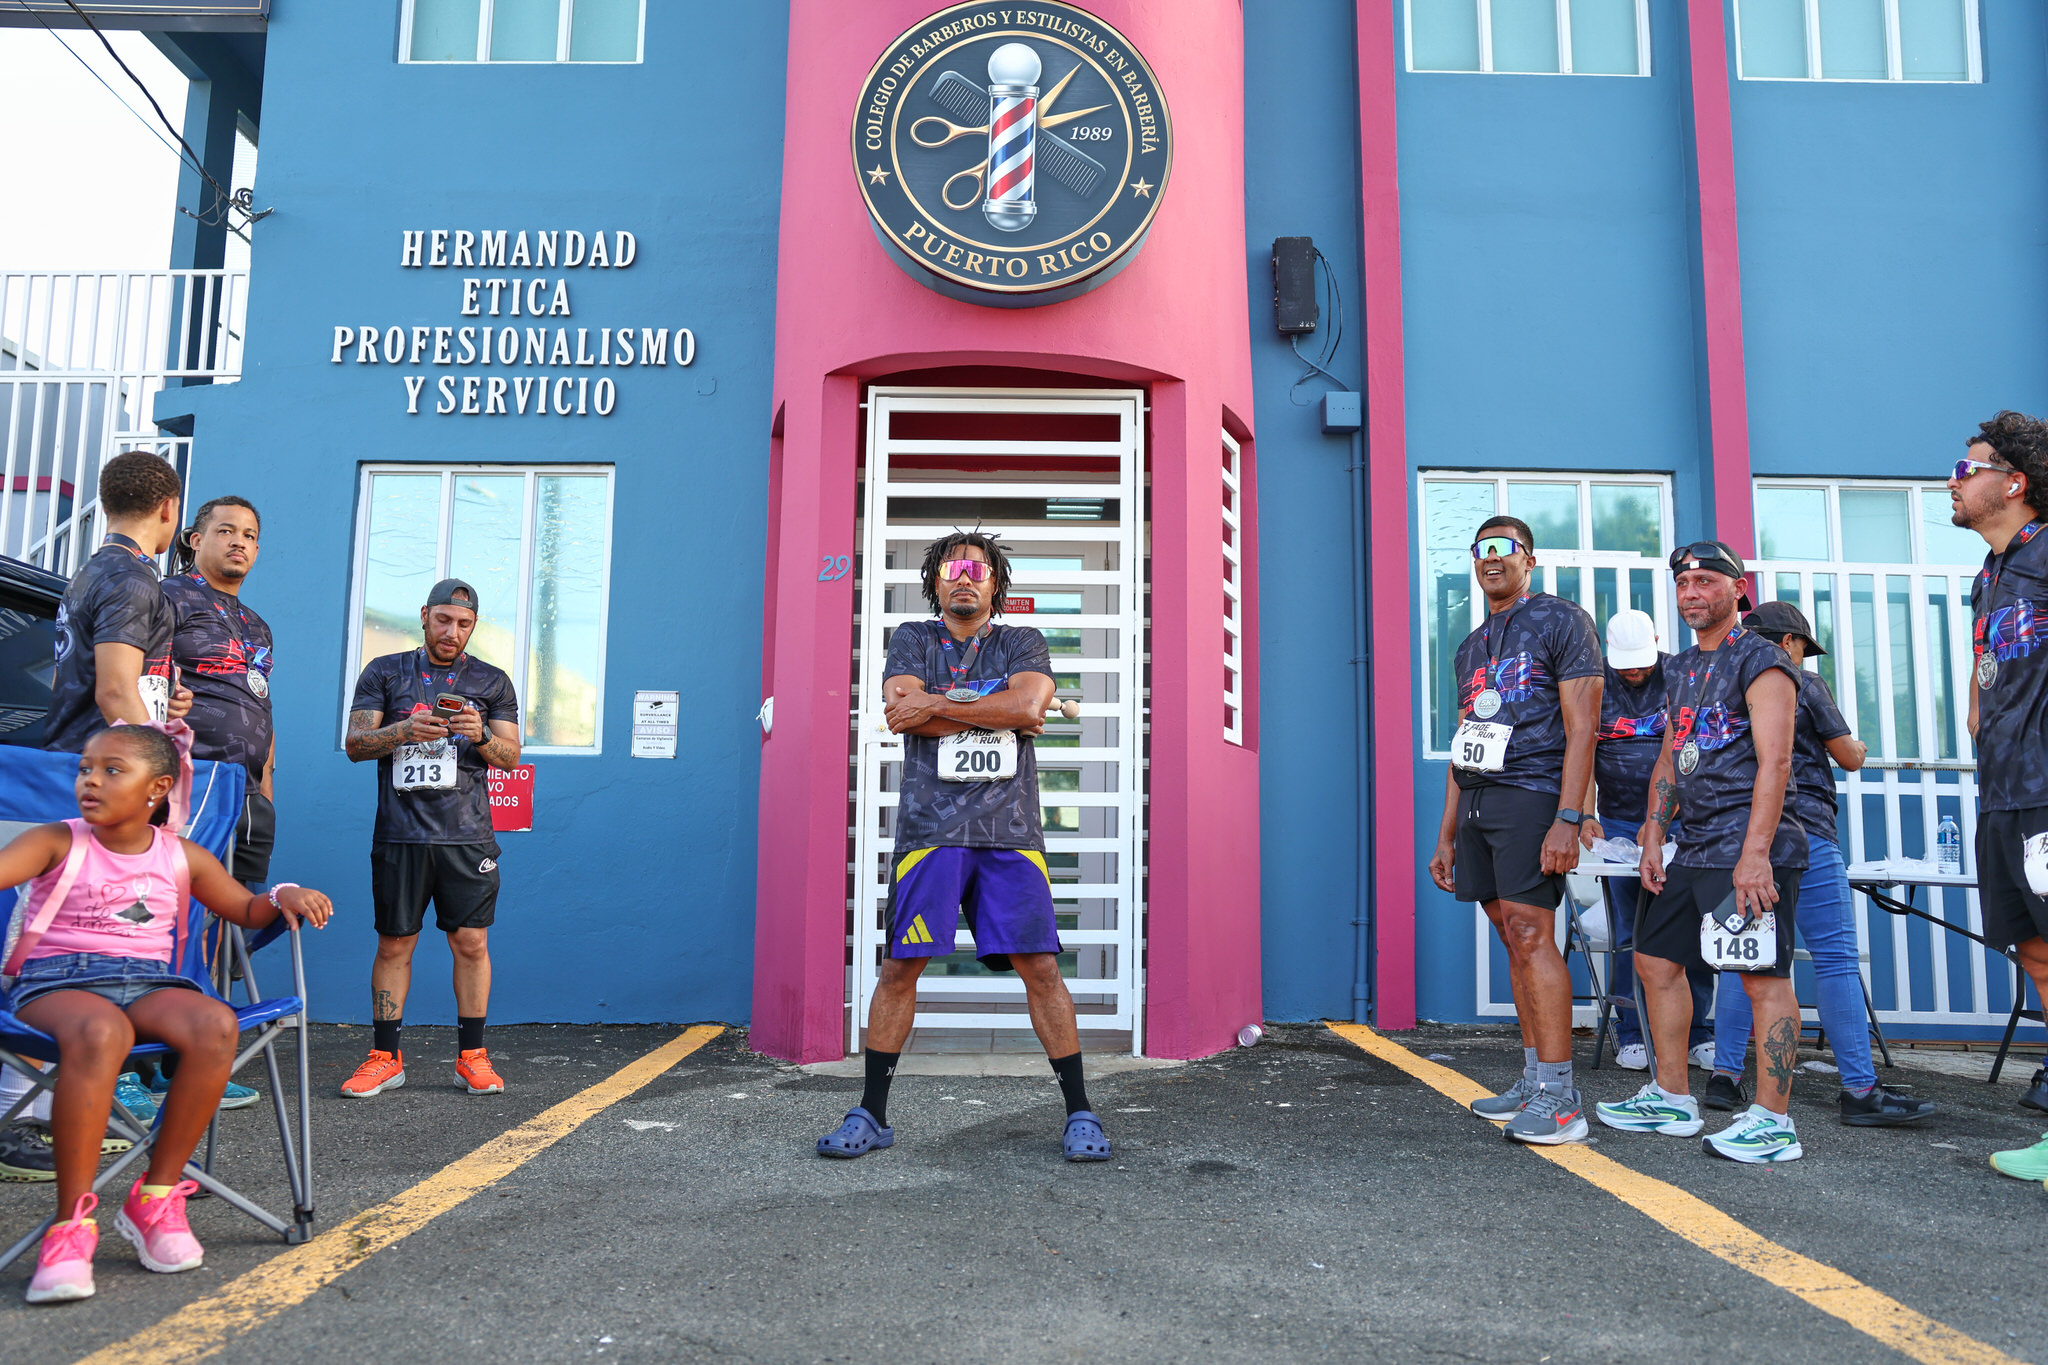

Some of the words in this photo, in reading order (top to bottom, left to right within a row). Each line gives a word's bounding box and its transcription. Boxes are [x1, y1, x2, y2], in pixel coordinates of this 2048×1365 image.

[866, 77, 897, 150] COLEGIO
[890, 54, 914, 78] DE
[909, 12, 997, 59] BARBEROS
[1000, 10, 1012, 25] Y
[1016, 10, 1108, 54] ESTILISTAS
[1104, 48, 1129, 72] EN
[1070, 126, 1113, 141] 1989
[400, 229, 638, 269] HERMANDAD
[902, 221, 1028, 278] PUERTO
[1037, 231, 1112, 276] RICO
[460, 278, 571, 316] ETICA
[331, 325, 696, 367] PROFESIONALISMO
[403, 375, 425, 414] Y
[436, 375, 617, 416] SERVICIO
[818, 555, 851, 581] 29
[640, 726, 670, 735] AVISO
[1471, 723, 1491, 732] FADE
[1477, 731, 1496, 739] RUN
[955, 750, 1001, 772] 200
[1463, 742, 1485, 763] 50
[403, 764, 442, 784] 213
[1713, 937, 1760, 960] 148
